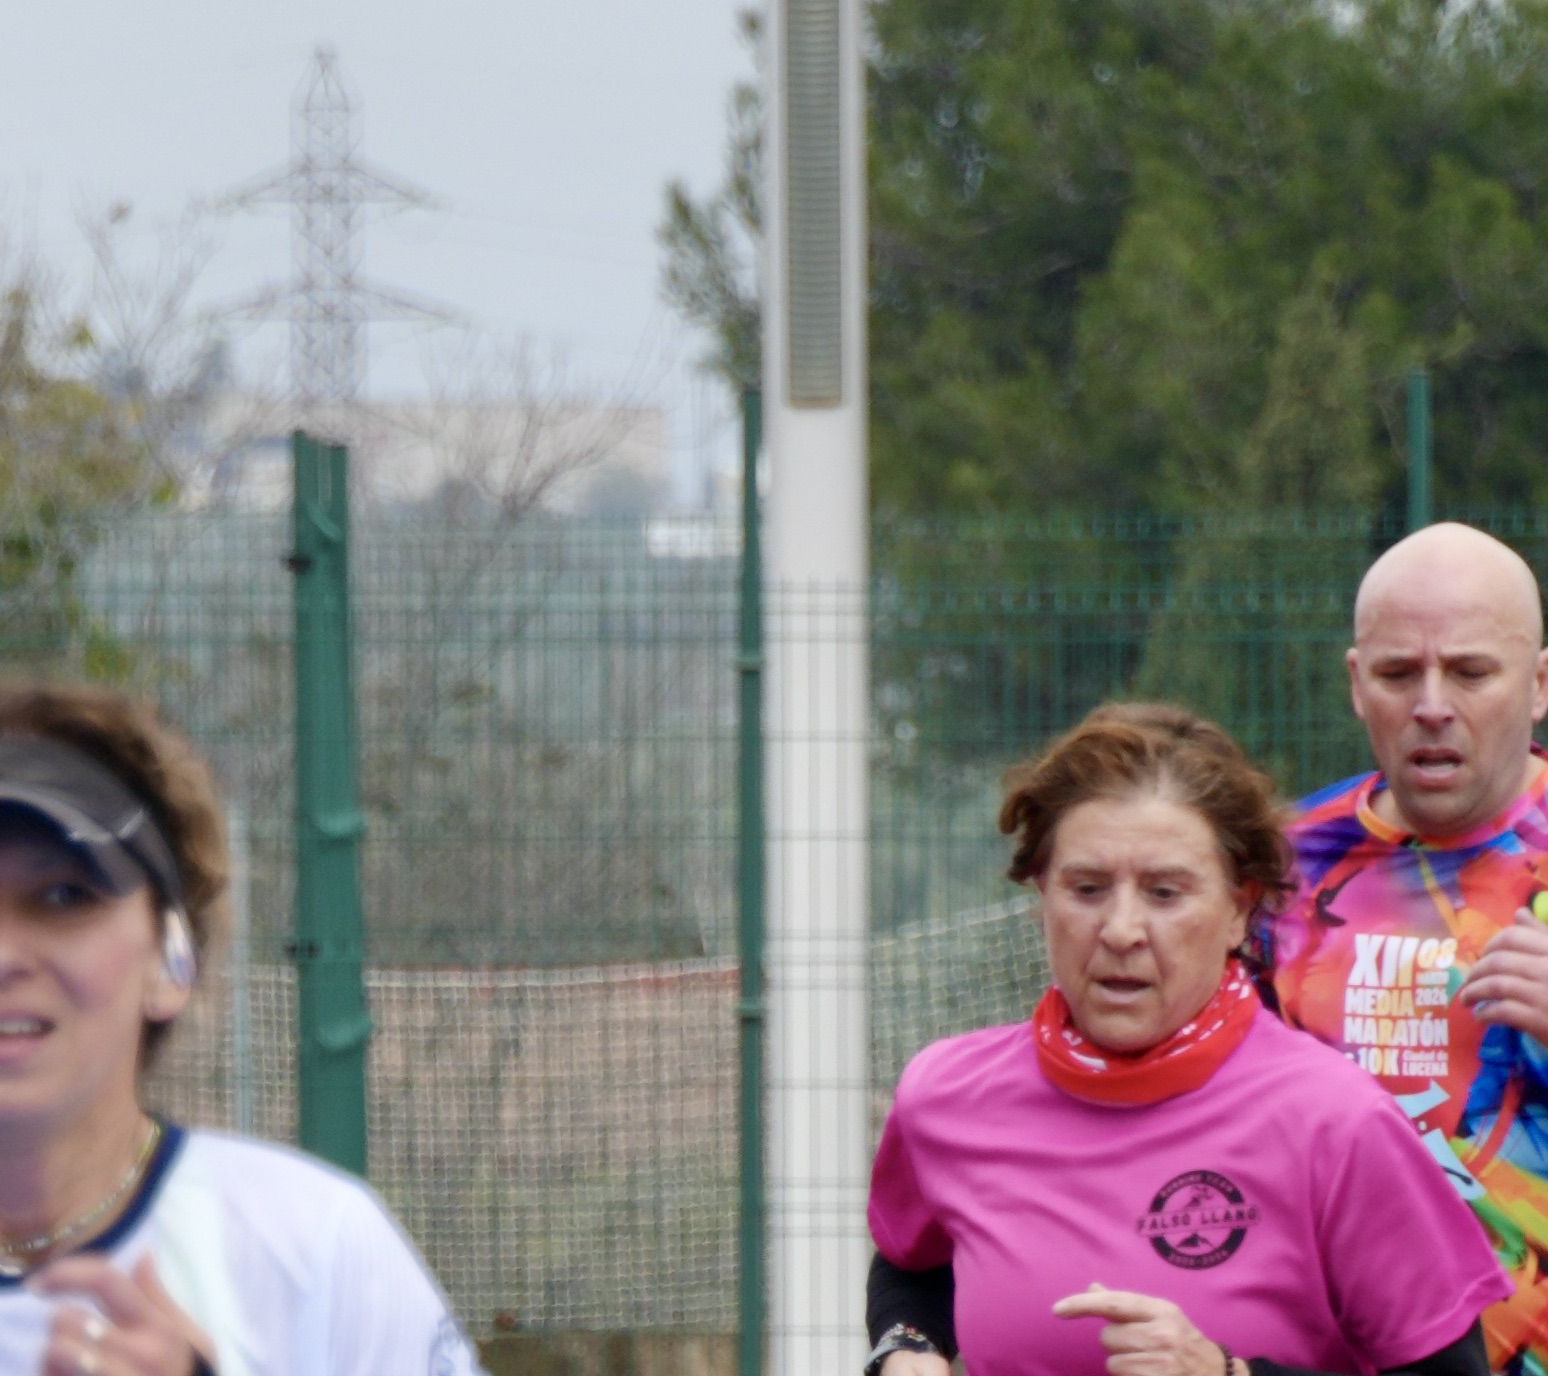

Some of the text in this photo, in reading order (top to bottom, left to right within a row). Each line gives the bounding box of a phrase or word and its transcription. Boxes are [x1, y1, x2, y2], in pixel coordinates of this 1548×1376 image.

[1347, 933, 1419, 988] XII
[1345, 986, 1415, 1016] MEDIA
[1415, 988, 1449, 1007] 2026
[1344, 1012, 1449, 1047] MARATÓN
[1358, 1047, 1400, 1076] 10K
[1402, 1062, 1449, 1076] LUCENA
[1137, 1207, 1258, 1231] FALSO LLANO
